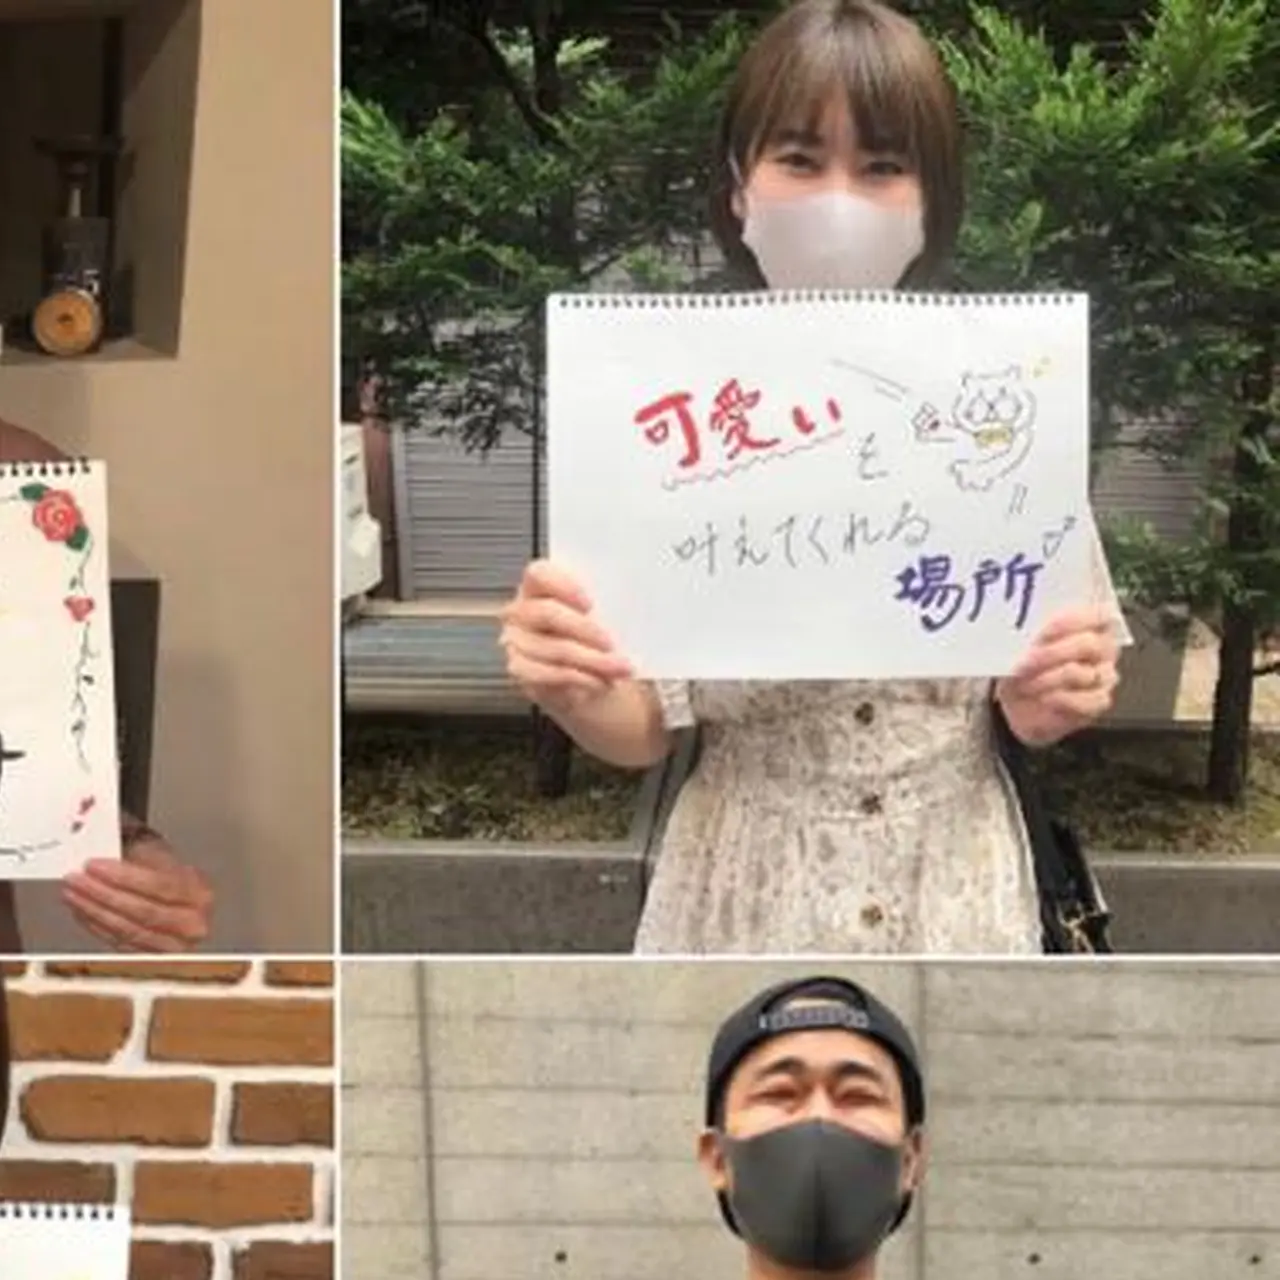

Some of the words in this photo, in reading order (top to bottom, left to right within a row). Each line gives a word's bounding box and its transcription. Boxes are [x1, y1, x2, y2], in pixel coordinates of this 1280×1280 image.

[671, 501, 931, 575] 叶えてくれる
[894, 553, 1044, 632] 場所
